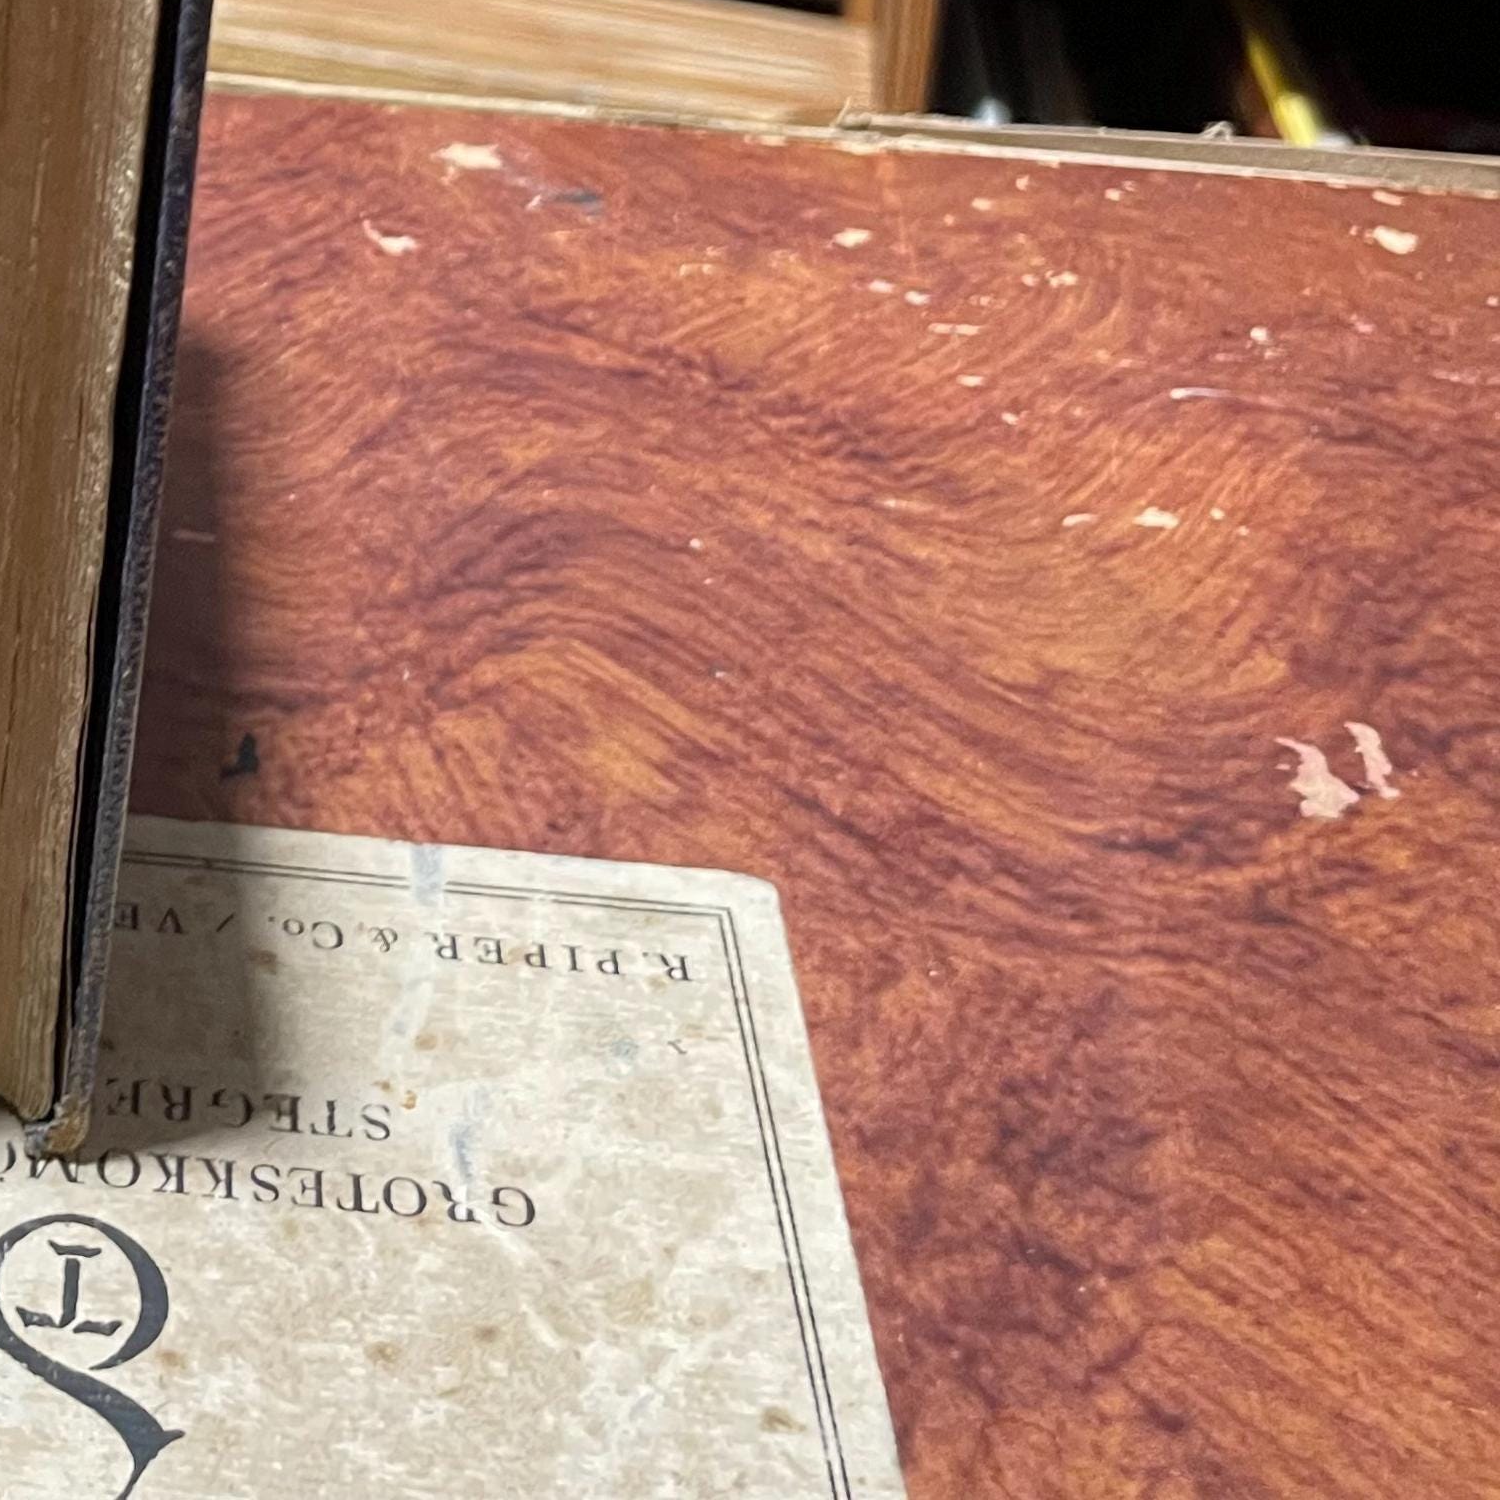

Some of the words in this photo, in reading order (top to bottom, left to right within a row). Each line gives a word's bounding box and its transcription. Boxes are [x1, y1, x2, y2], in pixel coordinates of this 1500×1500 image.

[370, 925, 399, 954] &
[424, 931, 625, 976] PIPER
[641, 950, 690, 983] R.
